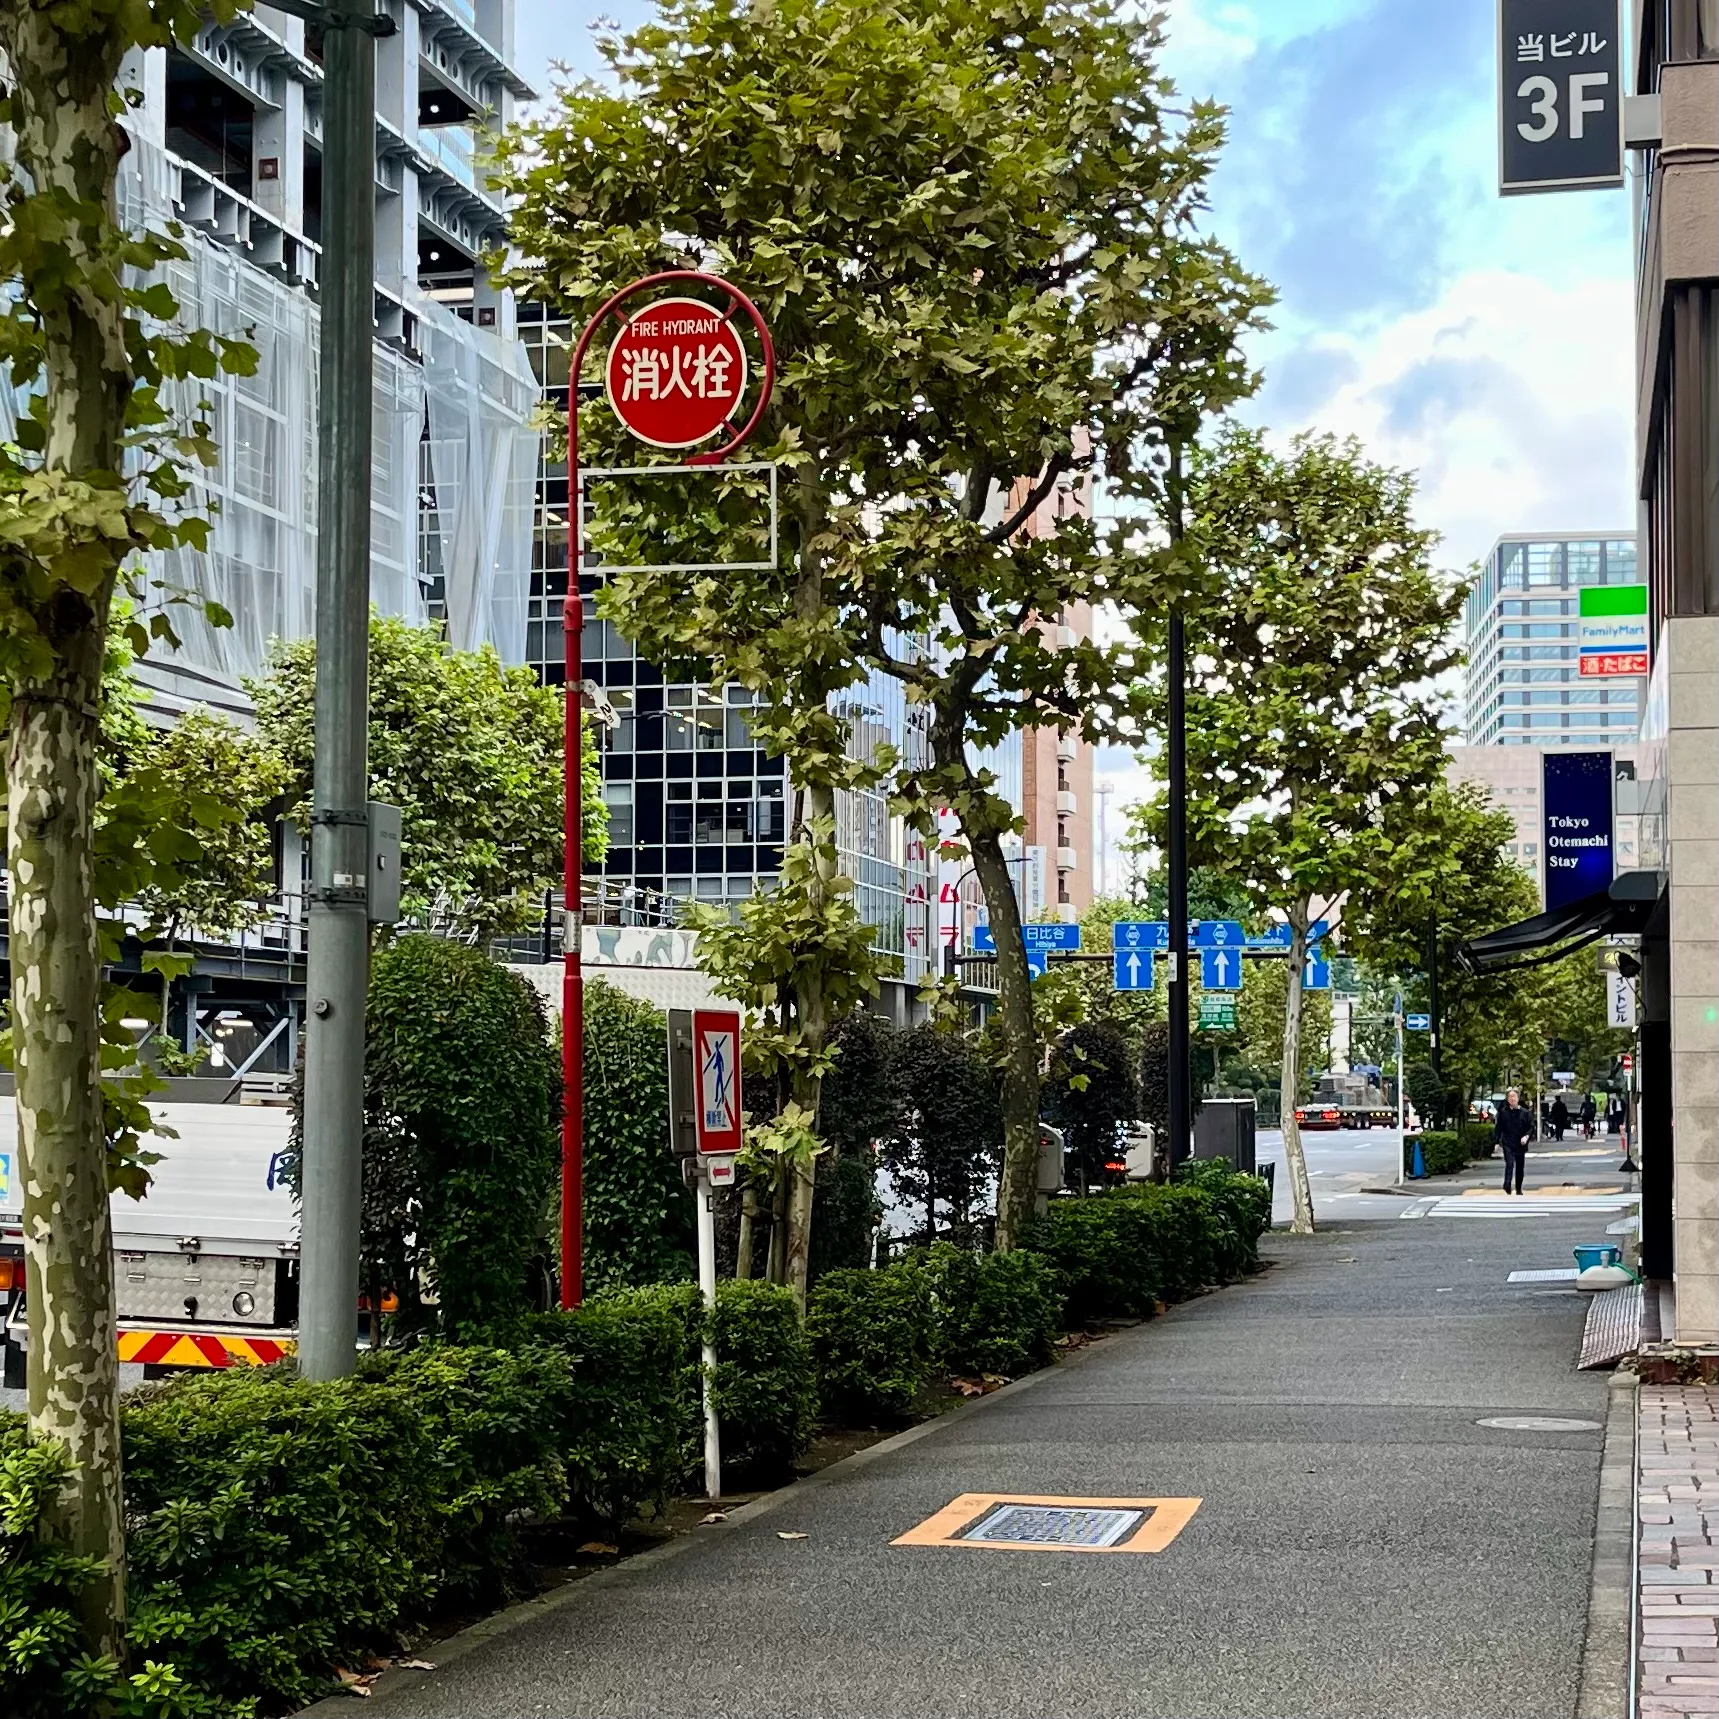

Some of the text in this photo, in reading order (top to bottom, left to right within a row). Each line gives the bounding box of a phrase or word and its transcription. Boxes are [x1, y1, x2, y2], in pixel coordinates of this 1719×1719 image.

[1517, 32, 1607, 62] 当ビル
[1516, 72, 1608, 143] 3F
[631, 318, 721, 337] FIRE HYDRANT
[621, 343, 734, 402] 消火栓
[1583, 626, 1645, 637] FamilyMart
[1549, 816, 1589, 829] Tokyo
[1549, 835, 1608, 848] Otemachi
[1549, 855, 1579, 868] Stay
[1026, 927, 1066, 940] 日比谷
